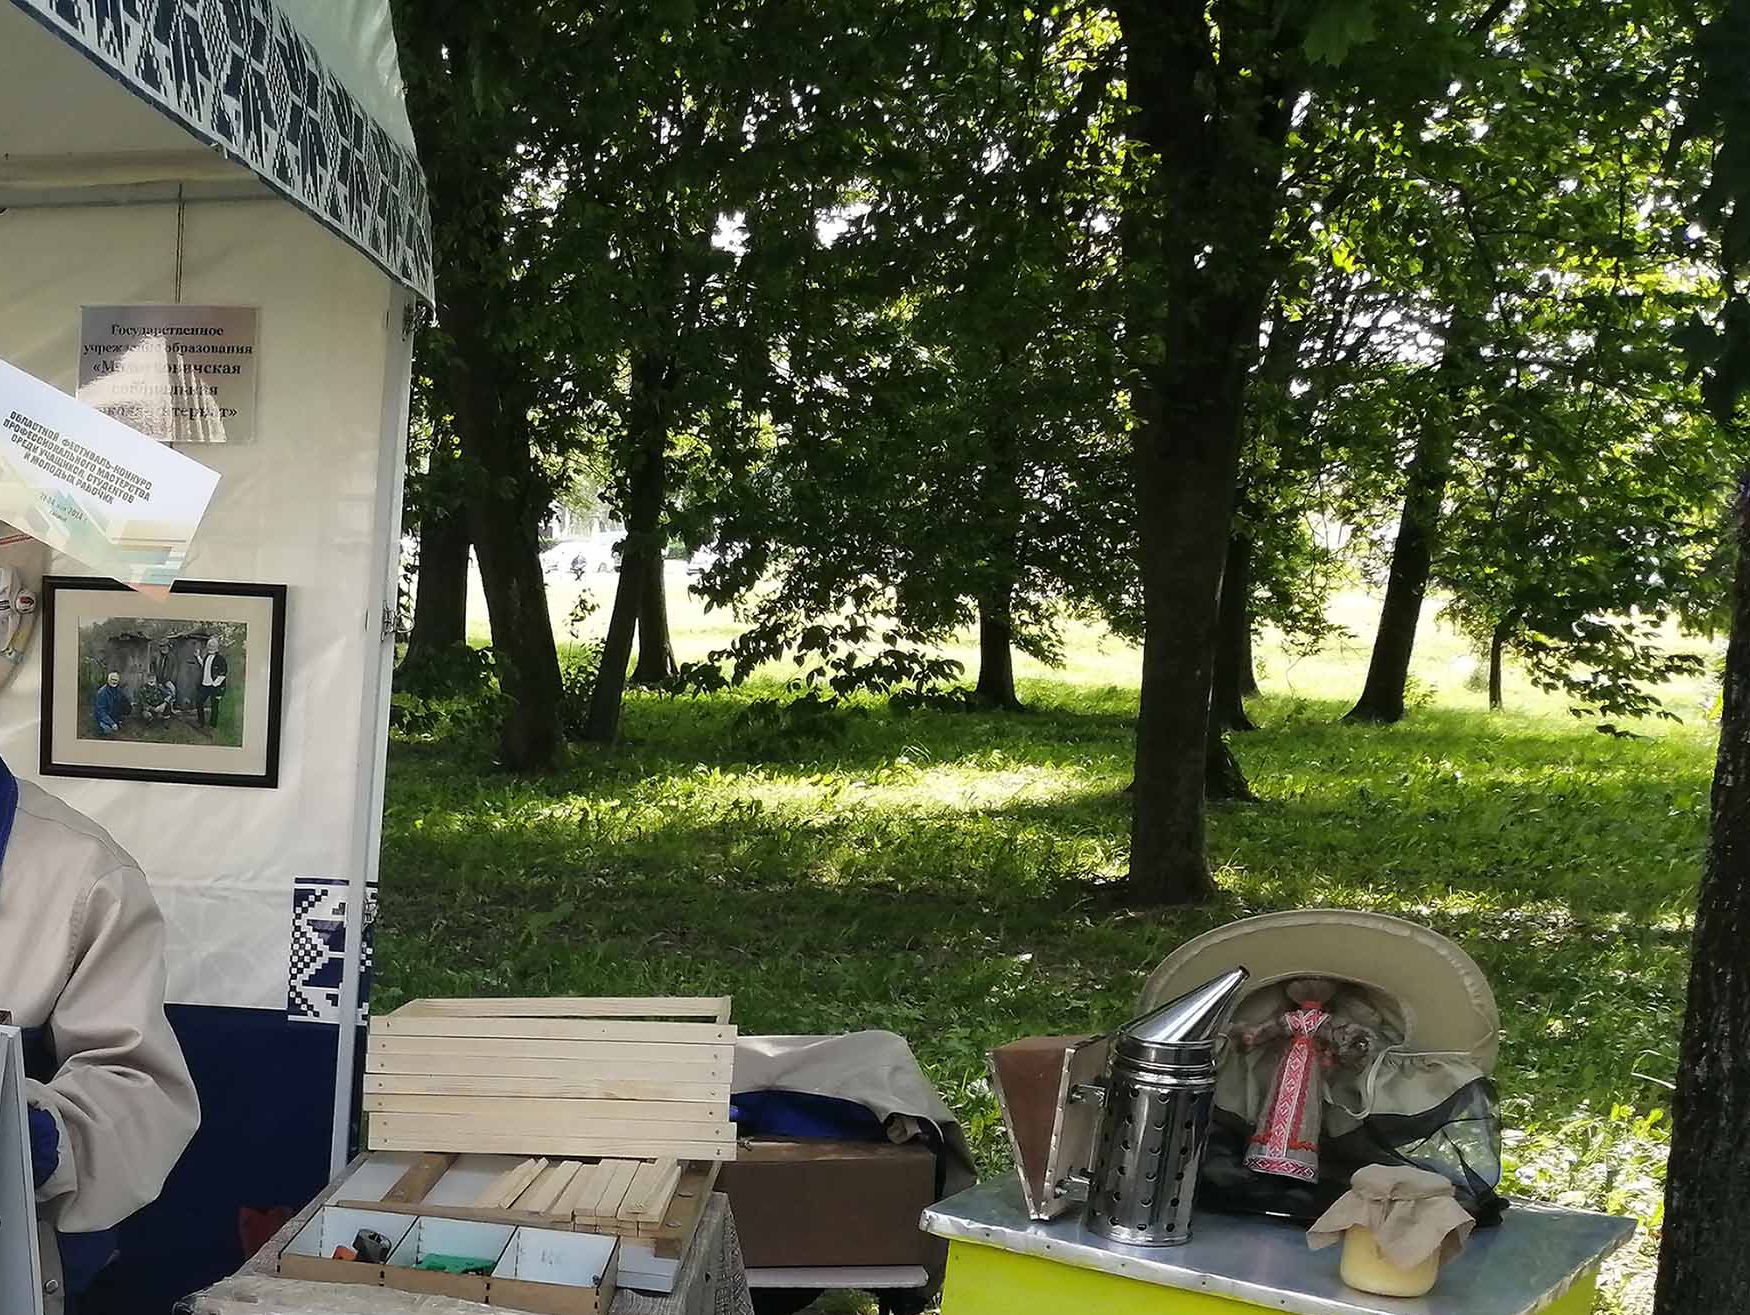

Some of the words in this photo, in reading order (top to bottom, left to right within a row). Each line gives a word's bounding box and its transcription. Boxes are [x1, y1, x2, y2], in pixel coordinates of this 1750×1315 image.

[165, 342, 253, 355] образования
[9, 410, 60, 442] ОБЛАСТНОЙ
[2, 418, 97, 473] ПРОФЕССИОНАЛЬНОГО
[98, 467, 151, 502] МАСТЕРСТВА
[10, 433, 40, 454] СРЕДИ
[86, 473, 135, 504] СТУДЕНТОВ
[30, 455, 76, 485] МОЛОДЫХ
[75, 479, 116, 505] РАБОЧИХ
